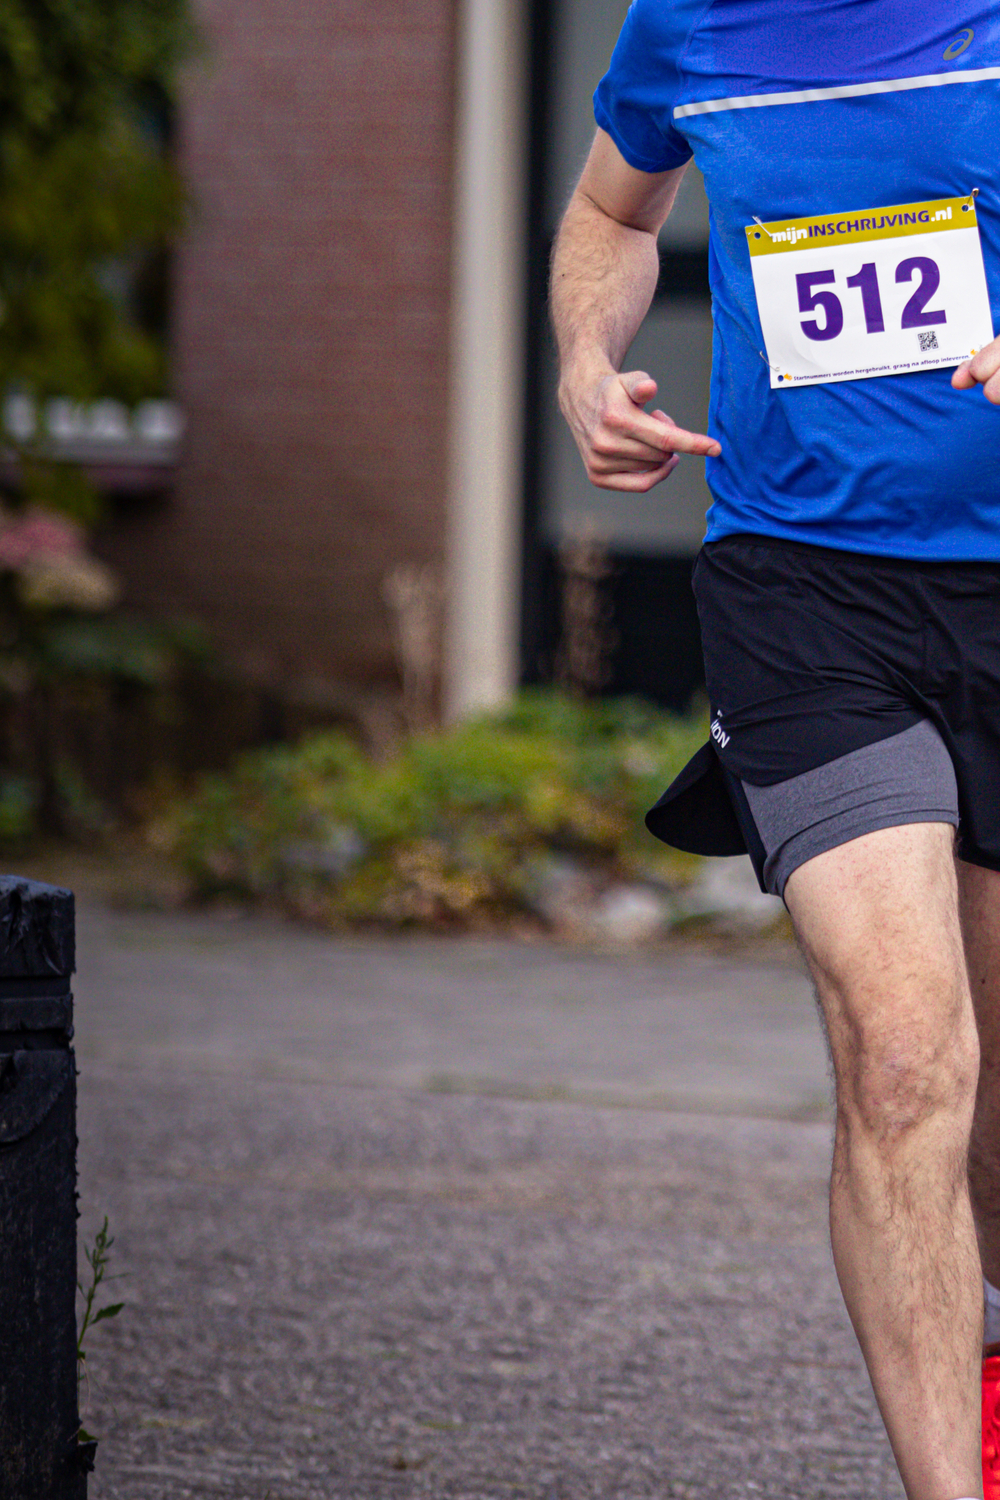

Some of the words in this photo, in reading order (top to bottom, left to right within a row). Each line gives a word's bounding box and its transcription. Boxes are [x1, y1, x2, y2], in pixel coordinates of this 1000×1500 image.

[772, 207, 952, 244] mijnINSCHRIJVING.nl
[795, 256, 947, 342] 512
[793, 373, 831, 381] Startnummers
[855, 365, 891, 374] hergebruikt,
[920, 358, 940, 367] afloop
